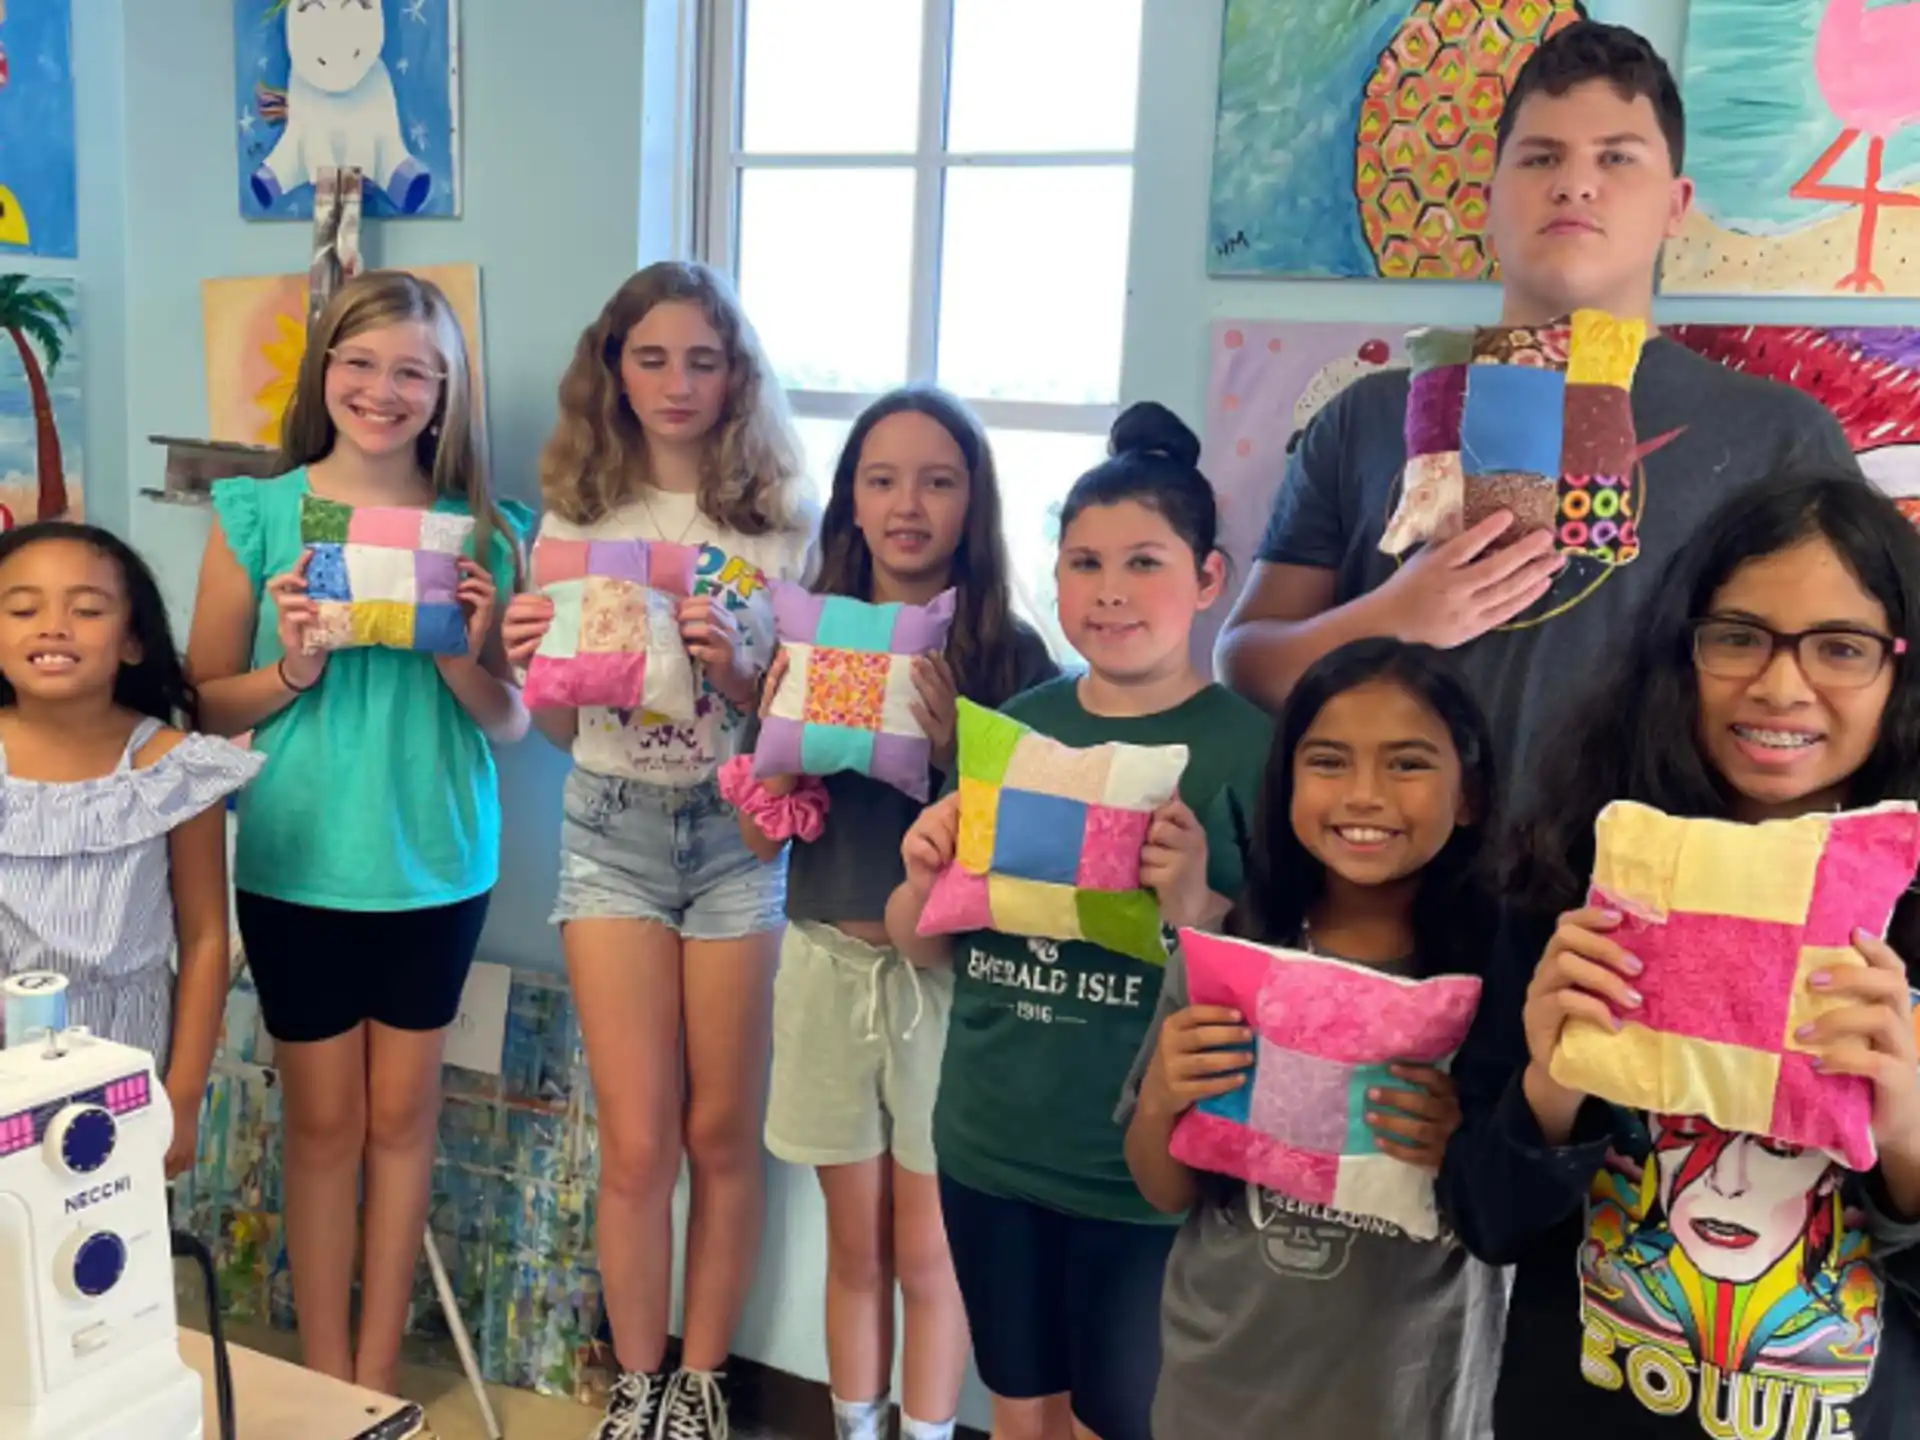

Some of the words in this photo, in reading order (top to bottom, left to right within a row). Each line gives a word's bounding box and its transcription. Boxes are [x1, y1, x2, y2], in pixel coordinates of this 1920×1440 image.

[967, 947, 1068, 995] EMERALD
[1076, 971, 1143, 1007] ISLE
[1015, 1000, 1053, 1024] 1916
[64, 1174, 132, 1215] NECCHI
